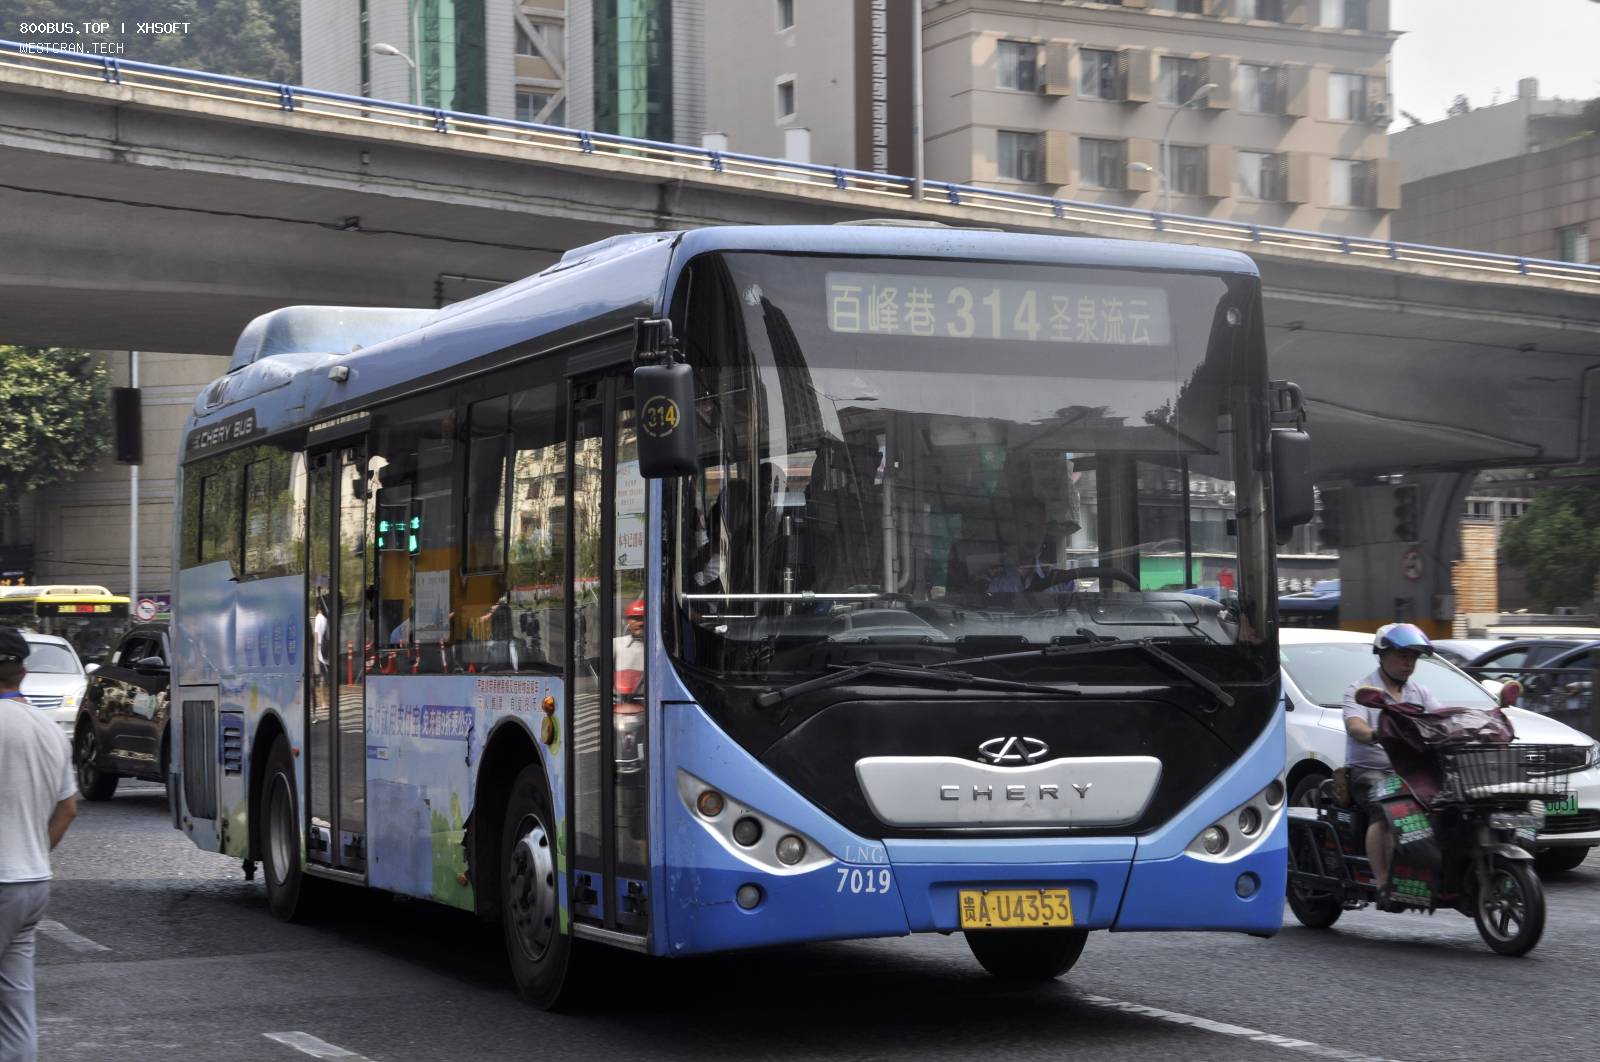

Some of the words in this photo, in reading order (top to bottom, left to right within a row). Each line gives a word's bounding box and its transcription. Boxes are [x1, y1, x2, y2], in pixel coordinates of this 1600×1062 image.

[830, 284, 936, 337] 百峰巷
[946, 286, 1041, 340] 314
[1049, 295, 1150, 346] 圣泉流云
[647, 405, 676, 427] 314
[200, 423, 231, 448] CHERY
[233, 416, 253, 438] BUS
[940, 782, 1093, 801] CHERY
[845, 846, 884, 863] LNG
[836, 868, 891, 894] 7019
